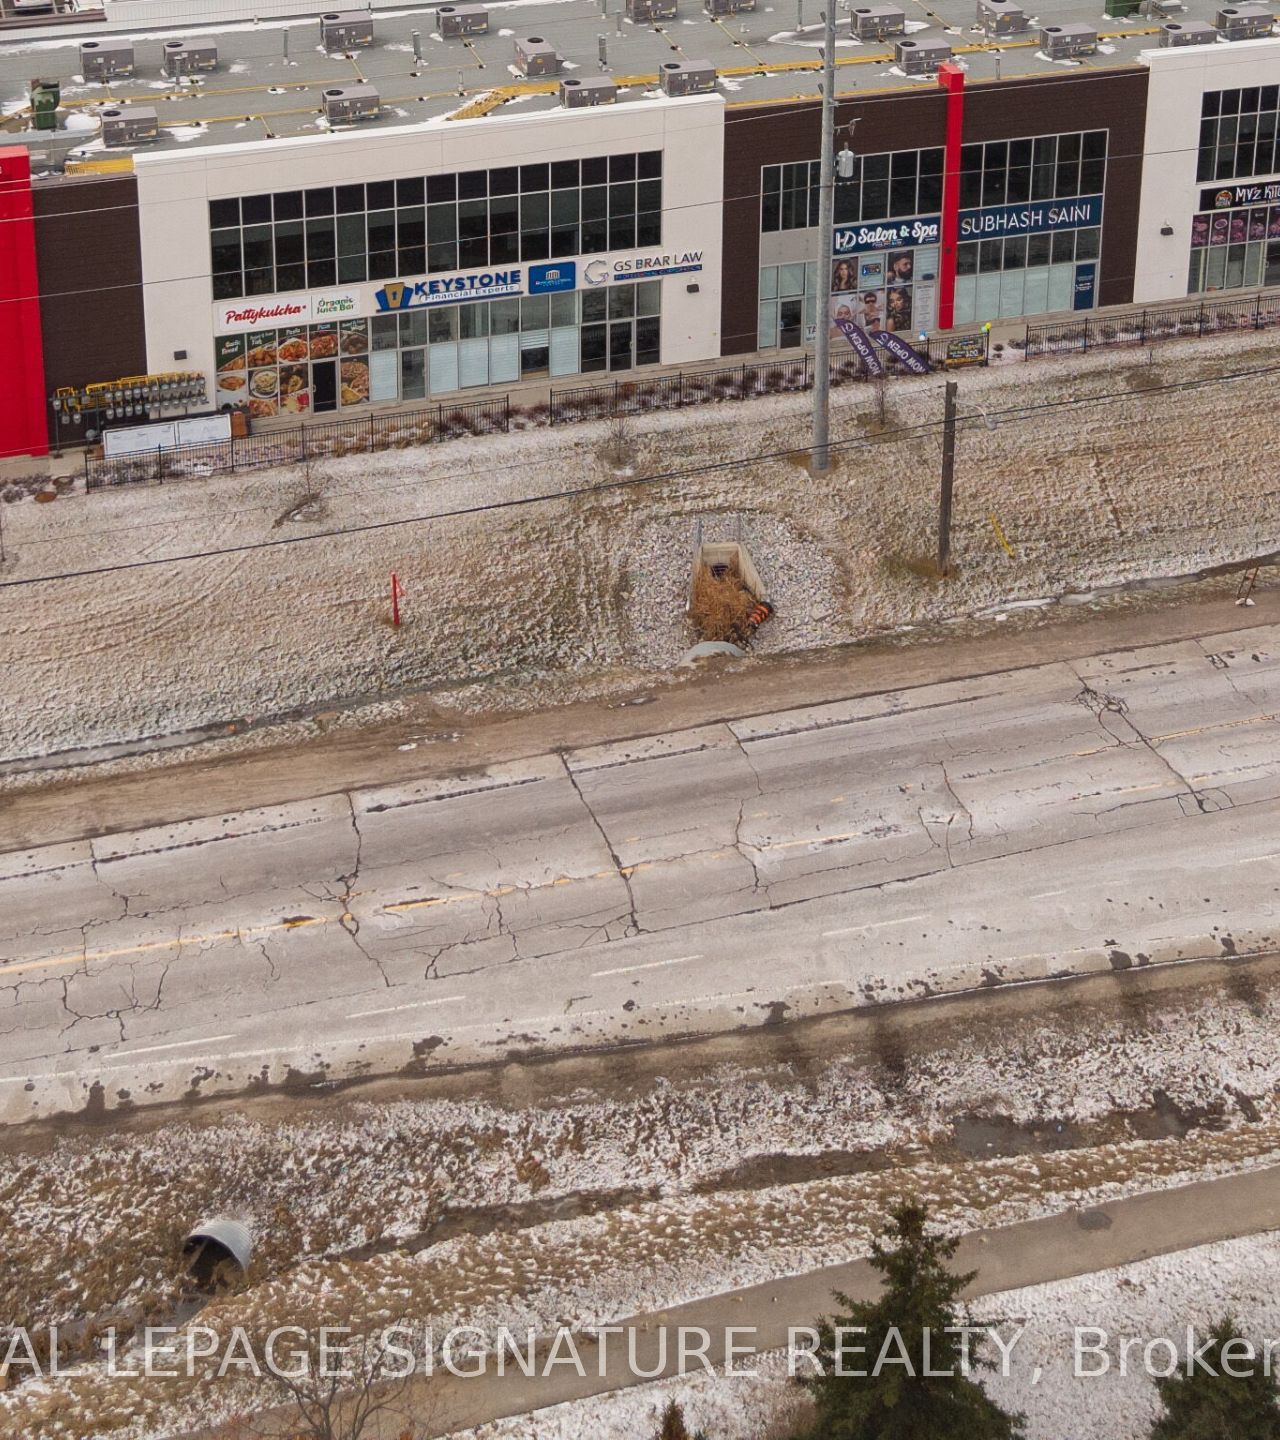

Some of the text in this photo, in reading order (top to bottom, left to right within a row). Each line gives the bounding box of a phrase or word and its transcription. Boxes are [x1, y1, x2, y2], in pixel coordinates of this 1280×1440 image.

[961, 204, 1091, 235] SUBHASH SAINI
[857, 226, 898, 244] Salon
[911, 221, 938, 244] Spa
[613, 251, 703, 272] GS BRAR LAW
[414, 269, 522, 296] KEYSTONE
[424, 285, 516, 302] Financial Experts
[318, 295, 354, 310] Organic
[339, 304, 354, 312] Bar
[224, 304, 302, 325] Pattykulcha
[849, 331, 882, 376] NOW OPEN
[886, 339, 927, 374] NOW OPEN
